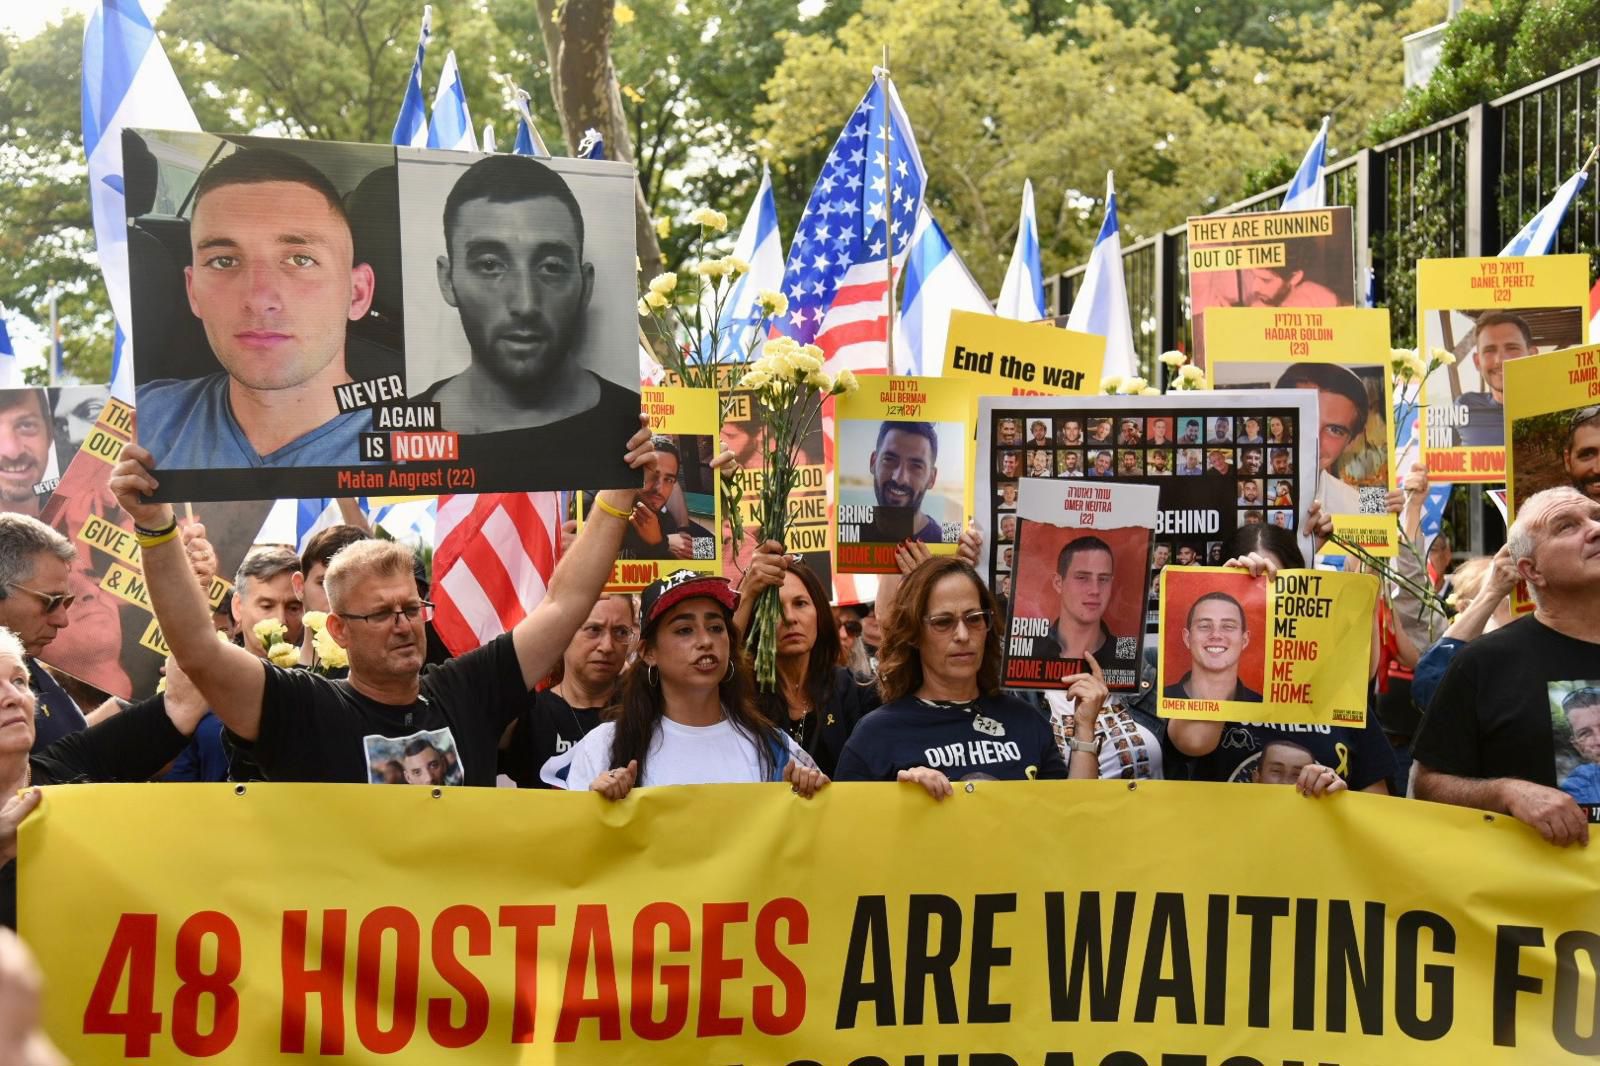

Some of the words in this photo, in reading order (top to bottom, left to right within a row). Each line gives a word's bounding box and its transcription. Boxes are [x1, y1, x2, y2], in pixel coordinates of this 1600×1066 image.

[1192, 223, 1227, 241] THEY
[1232, 220, 1259, 239] ARE
[1264, 215, 1329, 237] RUNNING
[1194, 250, 1220, 268] OUT
[1225, 249, 1242, 266] OF
[1248, 246, 1282, 264] TIME
[1471, 276, 1500, 288] DANIEL
[1503, 275, 1535, 288] PERETZ
[1494, 289, 1511, 303] (22)
[1304, 313, 1322, 326] הדר
[1265, 328, 1297, 340] HADAR
[1300, 328, 1333, 341] GOLDIN
[1290, 342, 1309, 357] (23)
[953, 346, 994, 374] End
[1000, 355, 1036, 382] the
[1043, 366, 1085, 391] war
[1568, 366, 1598, 385] TAMIR
[337, 374, 404, 410] NEVER
[880, 391, 896, 403] GALI
[897, 392, 926, 403] BERMAN
[1588, 381, 1600, 399] (3
[379, 406, 435, 428] AGAIN
[651, 404, 674, 416] COHEN
[1427, 405, 1470, 426] BRING
[89, 433, 125, 461] OUT
[366, 437, 383, 458] IS
[396, 435, 453, 459] NOW!
[1427, 426, 1453, 448] HIM
[1425, 452, 1467, 473] HOME
[338, 470, 383, 489] Matan
[388, 468, 442, 490] Angrest
[447, 467, 476, 488] (22)
[838, 505, 874, 524] BRING
[1064, 500, 1083, 511] OMER
[1085, 501, 1112, 512] NEUTRA
[1080, 512, 1095, 526] (22)
[1155, 510, 1220, 534] BEHIND
[85, 520, 129, 554] GIVE
[790, 529, 827, 550] NOW
[838, 524, 860, 543] HIM
[839, 545, 870, 565] HOME
[107, 570, 122, 590] &
[622, 561, 659, 584] NOW!
[1275, 575, 1322, 596] DON'T
[1275, 596, 1332, 618] FORGET
[1011, 616, 1049, 637] BRING
[1274, 617, 1297, 638] ME
[1008, 637, 1034, 657] HIM
[1273, 639, 1318, 661] BRING
[1007, 660, 1042, 680] HOME
[1271, 661, 1294, 682] ME
[1270, 683, 1313, 704] HOME.
[1162, 699, 1186, 711] OMER
[1188, 701, 1220, 712] NEUTRA
[924, 743, 967, 768] OUR
[969, 740, 1022, 765] HERO
[83, 910, 241, 1058] 48
[280, 897, 809, 1056] HOSTAGES
[835, 892, 1018, 1031] ARE
[1043, 891, 1457, 1041] WAITING
[1493, 924, 1600, 1057] FO
